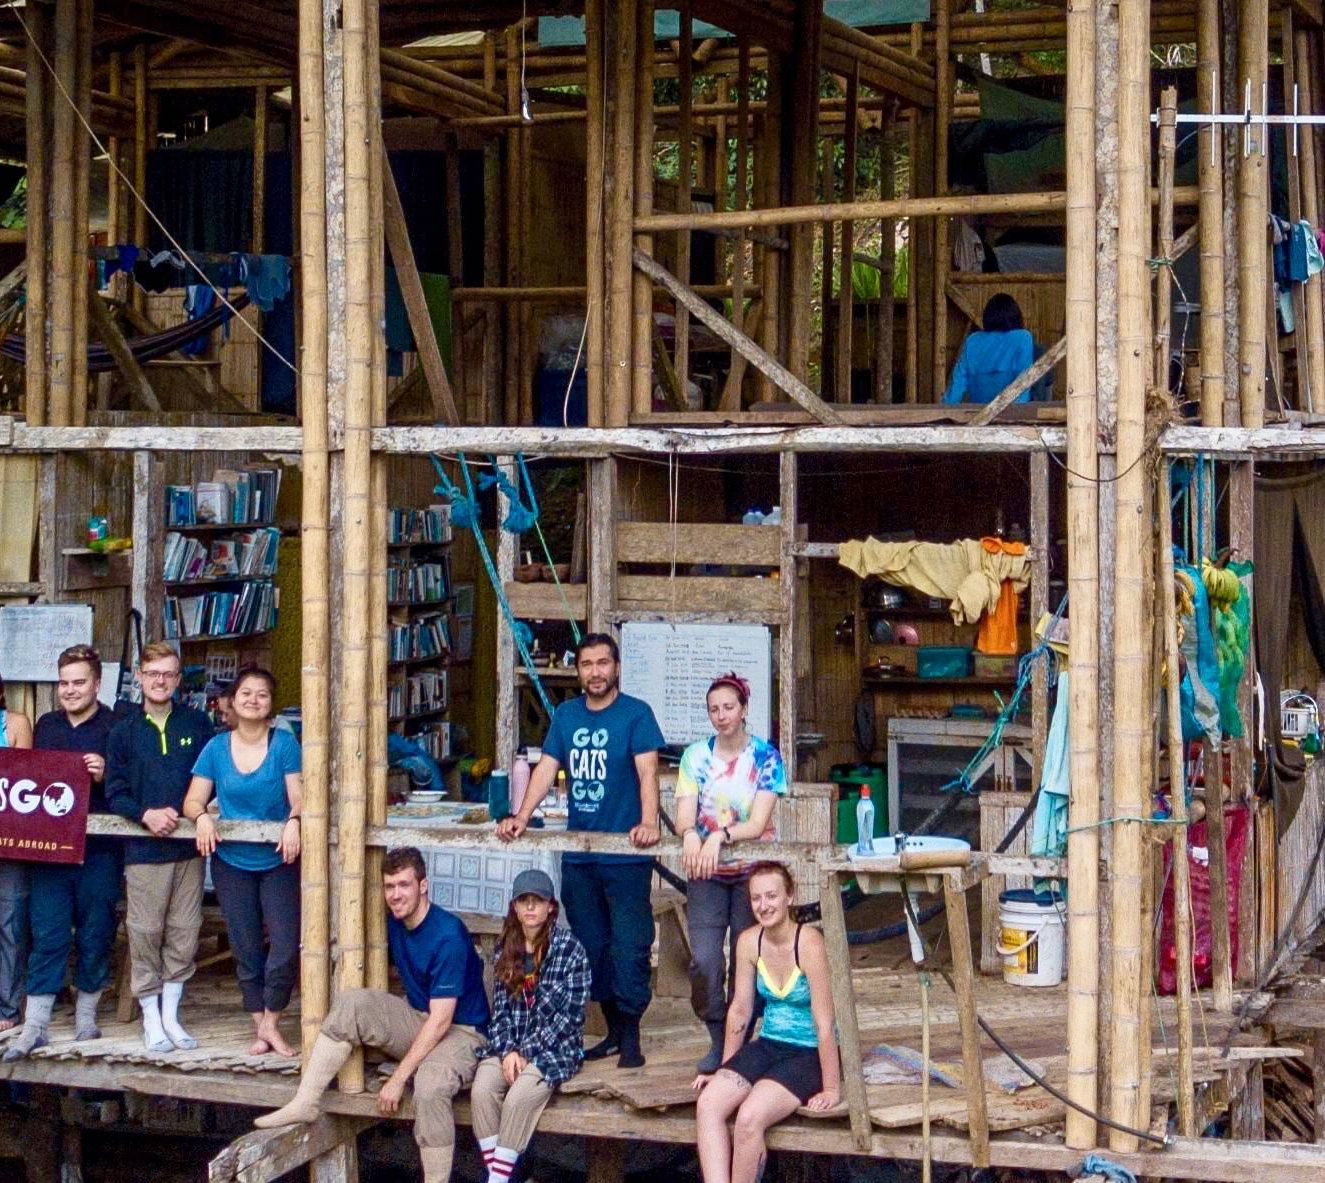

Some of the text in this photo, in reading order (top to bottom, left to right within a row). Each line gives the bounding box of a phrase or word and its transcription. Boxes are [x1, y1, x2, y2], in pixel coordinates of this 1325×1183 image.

[572, 727, 609, 748] GO
[569, 748, 607, 780] CATS
[9, 779, 75, 817] GO
[572, 780, 605, 801] GO
[18, 839, 58, 851] ABROAD
